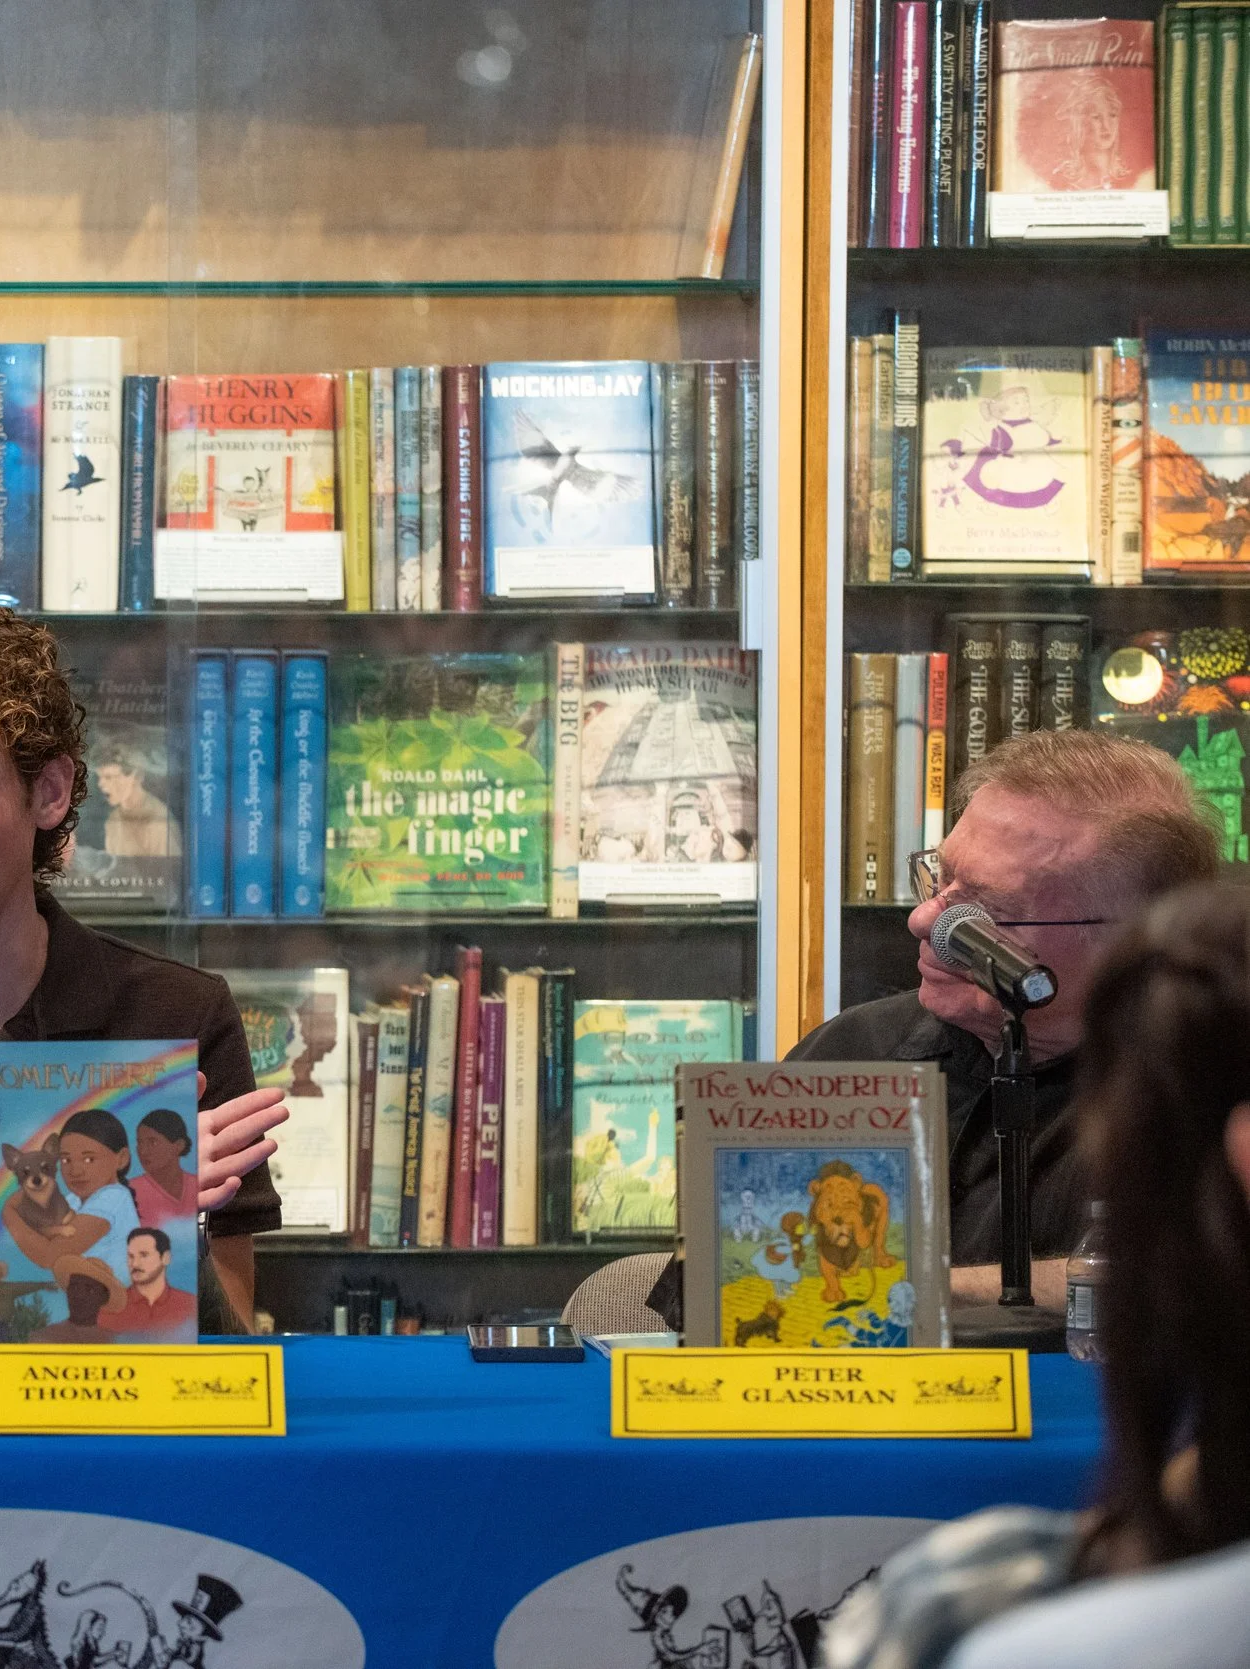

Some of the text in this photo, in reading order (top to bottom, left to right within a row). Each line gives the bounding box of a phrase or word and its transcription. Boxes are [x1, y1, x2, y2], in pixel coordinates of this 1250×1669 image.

[977, 39, 989, 80] WIND
[1101, 32, 1144, 71] Rain
[975, 82, 986, 96] IN
[897, 66, 919, 194] The Young Unicorns
[940, 32, 954, 196] A SWIFTLY TILTING PLANET
[975, 98, 986, 127] THE
[973, 128, 986, 171] DOOR
[206, 379, 296, 399] HENRY
[490, 376, 643, 398] MOCKINGJAY
[880, 359, 892, 422] Earthfasts
[894, 324, 919, 427] DRAGONDRUMS
[51, 401, 111, 412] STRANGE
[188, 405, 313, 425] HUGGINS
[202, 440, 310, 452] BEVERLY CLEARY
[898, 436, 911, 472] ANNE
[458, 428, 472, 543] CATCHING FIRE
[587, 647, 673, 676] ROALD
[589, 674, 612, 688] THE
[614, 665, 688, 680] WONDERFUL
[693, 667, 731, 683] STORY
[558, 654, 580, 746] The BFG
[614, 677, 720, 695] HENRY SUGAR
[933, 670, 944, 722] PULLMAN
[969, 665, 989, 703] THE
[1012, 665, 1031, 704] THE
[1055, 665, 1074, 704] THE
[931, 767, 942, 775] A
[932, 742, 943, 765] WAS
[295, 710, 312, 875] King the Middle March
[381, 769, 488, 783] ROALD DAHL
[931, 776, 943, 799] RAT!
[345, 778, 527, 825] the magic
[407, 819, 529, 867] finger
[514, 986, 526, 1108] THIS STAR SHALL ABIDE
[409, 1087, 422, 1112] Great
[691, 1070, 927, 1099] The WONDERFUL
[460, 1042, 474, 1172] LITTLE BO IN FRANCE
[707, 1101, 913, 1132] WIZARD of OZ
[406, 1115, 420, 1158] American
[482, 1103, 500, 1166] PET
[404, 1160, 418, 1197] Mousical
[23, 1365, 136, 1382] ANGELO
[774, 1366, 864, 1383] PETER
[19, 1386, 139, 1402] THOMAS
[741, 1387, 897, 1404] GLASSMAN
